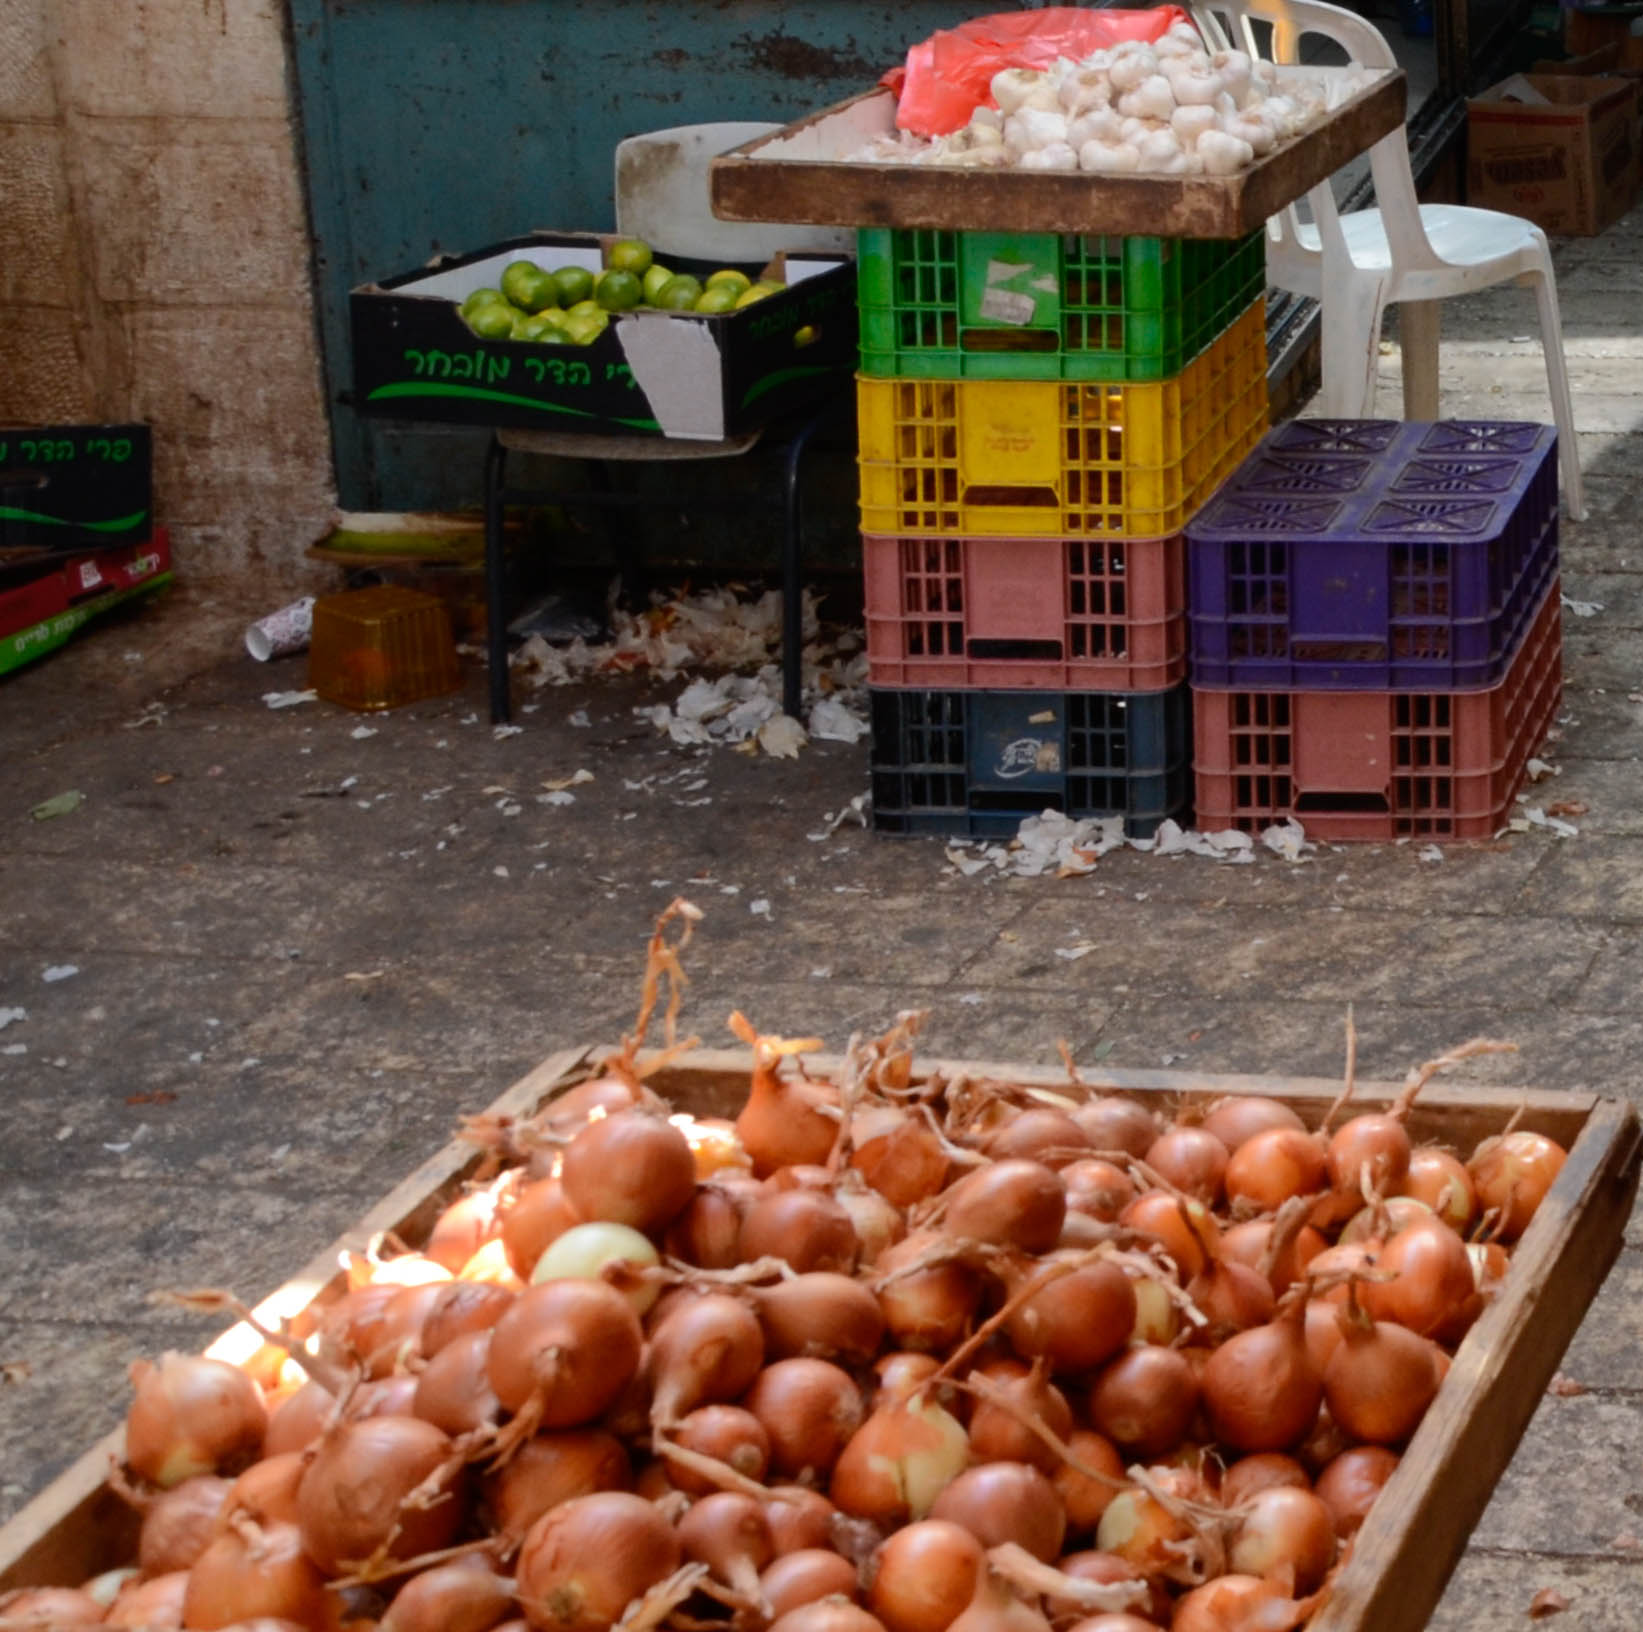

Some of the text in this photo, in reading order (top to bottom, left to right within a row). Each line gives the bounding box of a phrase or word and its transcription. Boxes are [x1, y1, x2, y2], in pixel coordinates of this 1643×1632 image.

[402, 347, 640, 390] רי הדר מובחר
[19, 437, 134, 464] פרי הדר
